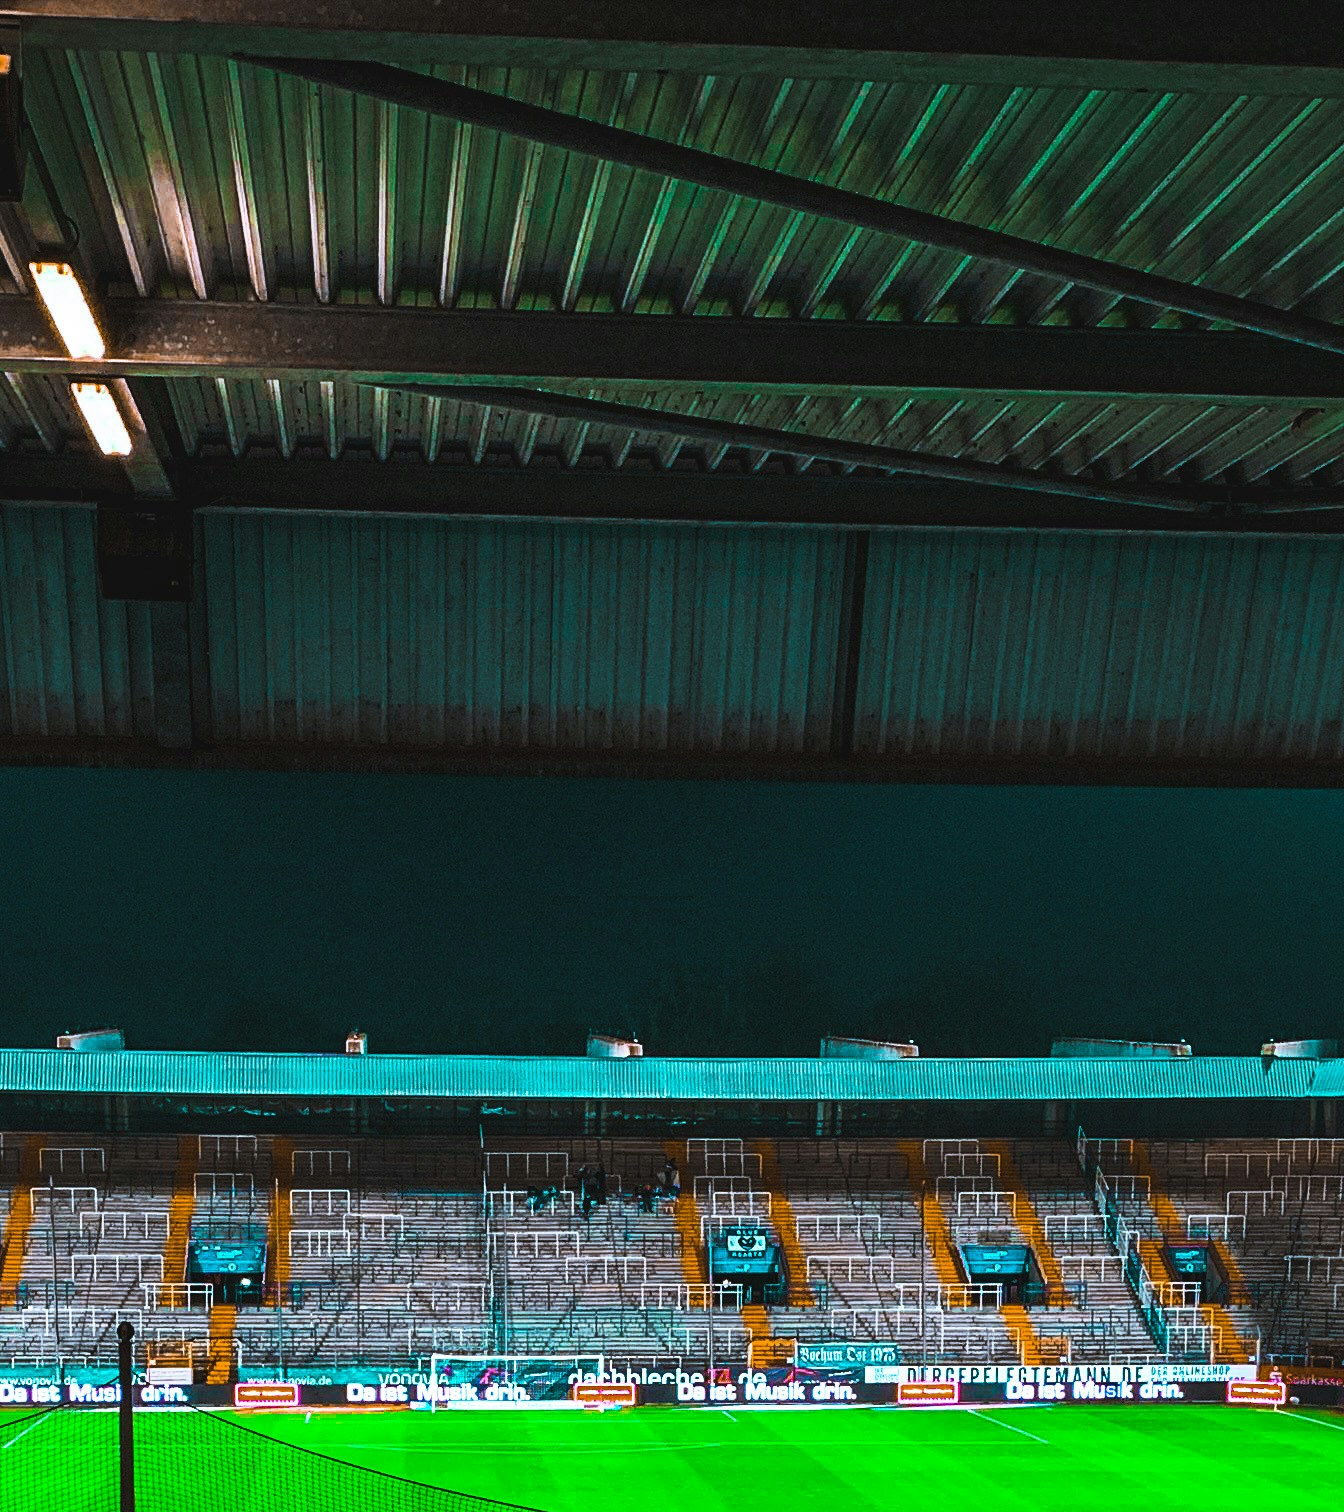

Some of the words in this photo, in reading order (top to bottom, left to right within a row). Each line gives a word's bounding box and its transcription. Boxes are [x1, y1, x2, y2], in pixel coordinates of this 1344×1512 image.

[800, 1347, 842, 1362] Bochum
[846, 1347, 867, 1361] Ost
[32, 1384, 61, 1402] ist
[69, 1384, 122, 1402] Musi
[347, 1383, 377, 1402] Da
[380, 1384, 407, 1402] ist
[417, 1384, 479, 1401] Musik
[678, 1383, 705, 1401] Da
[710, 1384, 736, 1400] ist
[746, 1383, 806, 1400] Musik
[813, 1383, 857, 1400] drin.
[1006, 1382, 1034, 1399] Da
[1038, 1382, 1065, 1399] ist
[1073, 1382, 1133, 1399] Musik
[1139, 1382, 1184, 1399] drin.
